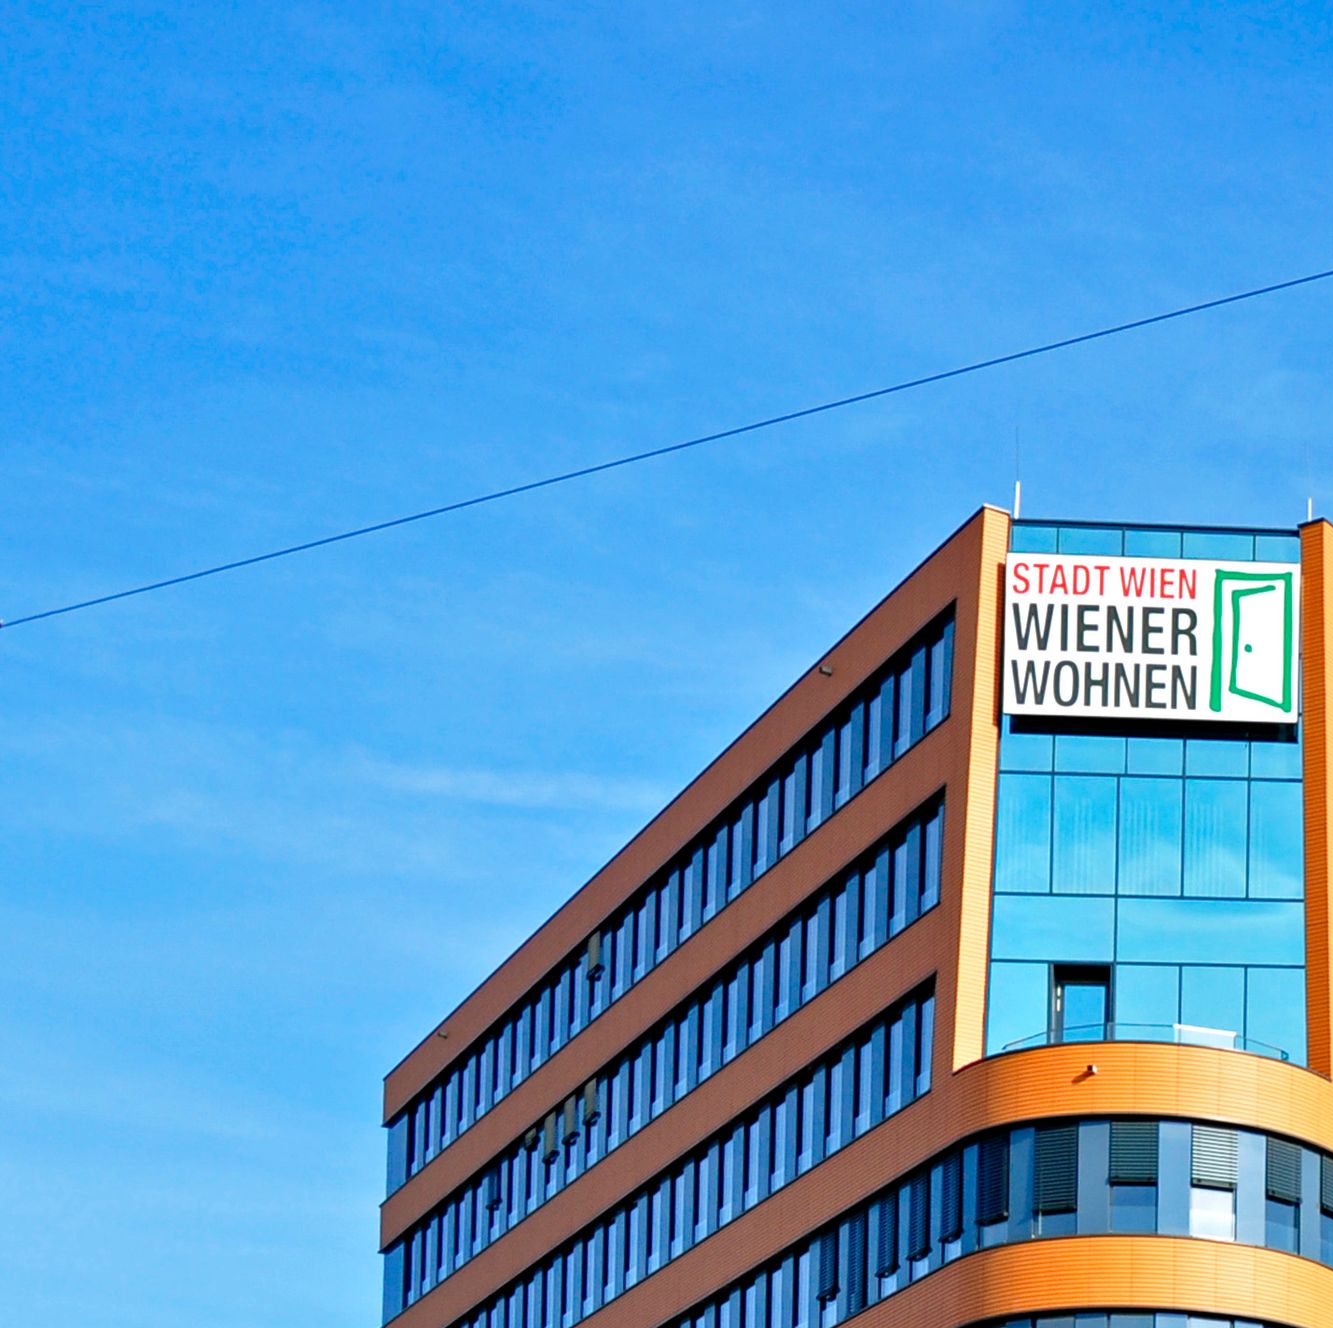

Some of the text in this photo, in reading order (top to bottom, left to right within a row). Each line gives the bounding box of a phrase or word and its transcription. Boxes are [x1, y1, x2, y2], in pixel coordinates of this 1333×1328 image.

[1012, 562, 1197, 599] STADT WIEN
[1012, 603, 1198, 656] WIENER
[1011, 660, 1197, 710] WOHNEN
